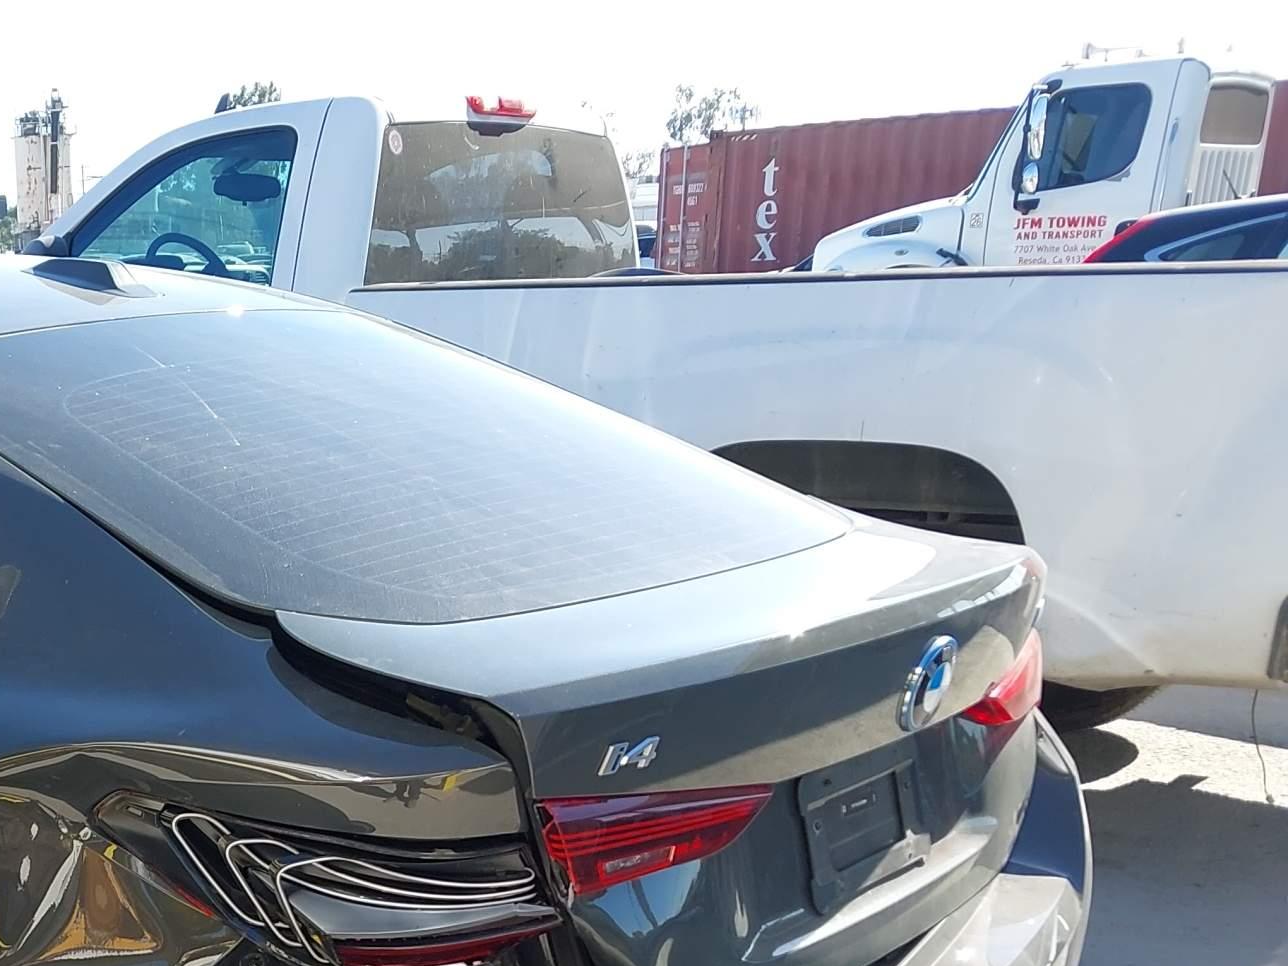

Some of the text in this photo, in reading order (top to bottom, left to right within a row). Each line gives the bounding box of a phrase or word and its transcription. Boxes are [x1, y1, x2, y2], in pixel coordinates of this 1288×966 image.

[1014, 215, 1107, 230] JFM TOWING
[1016, 229, 1104, 241] AND TRANSPORT
